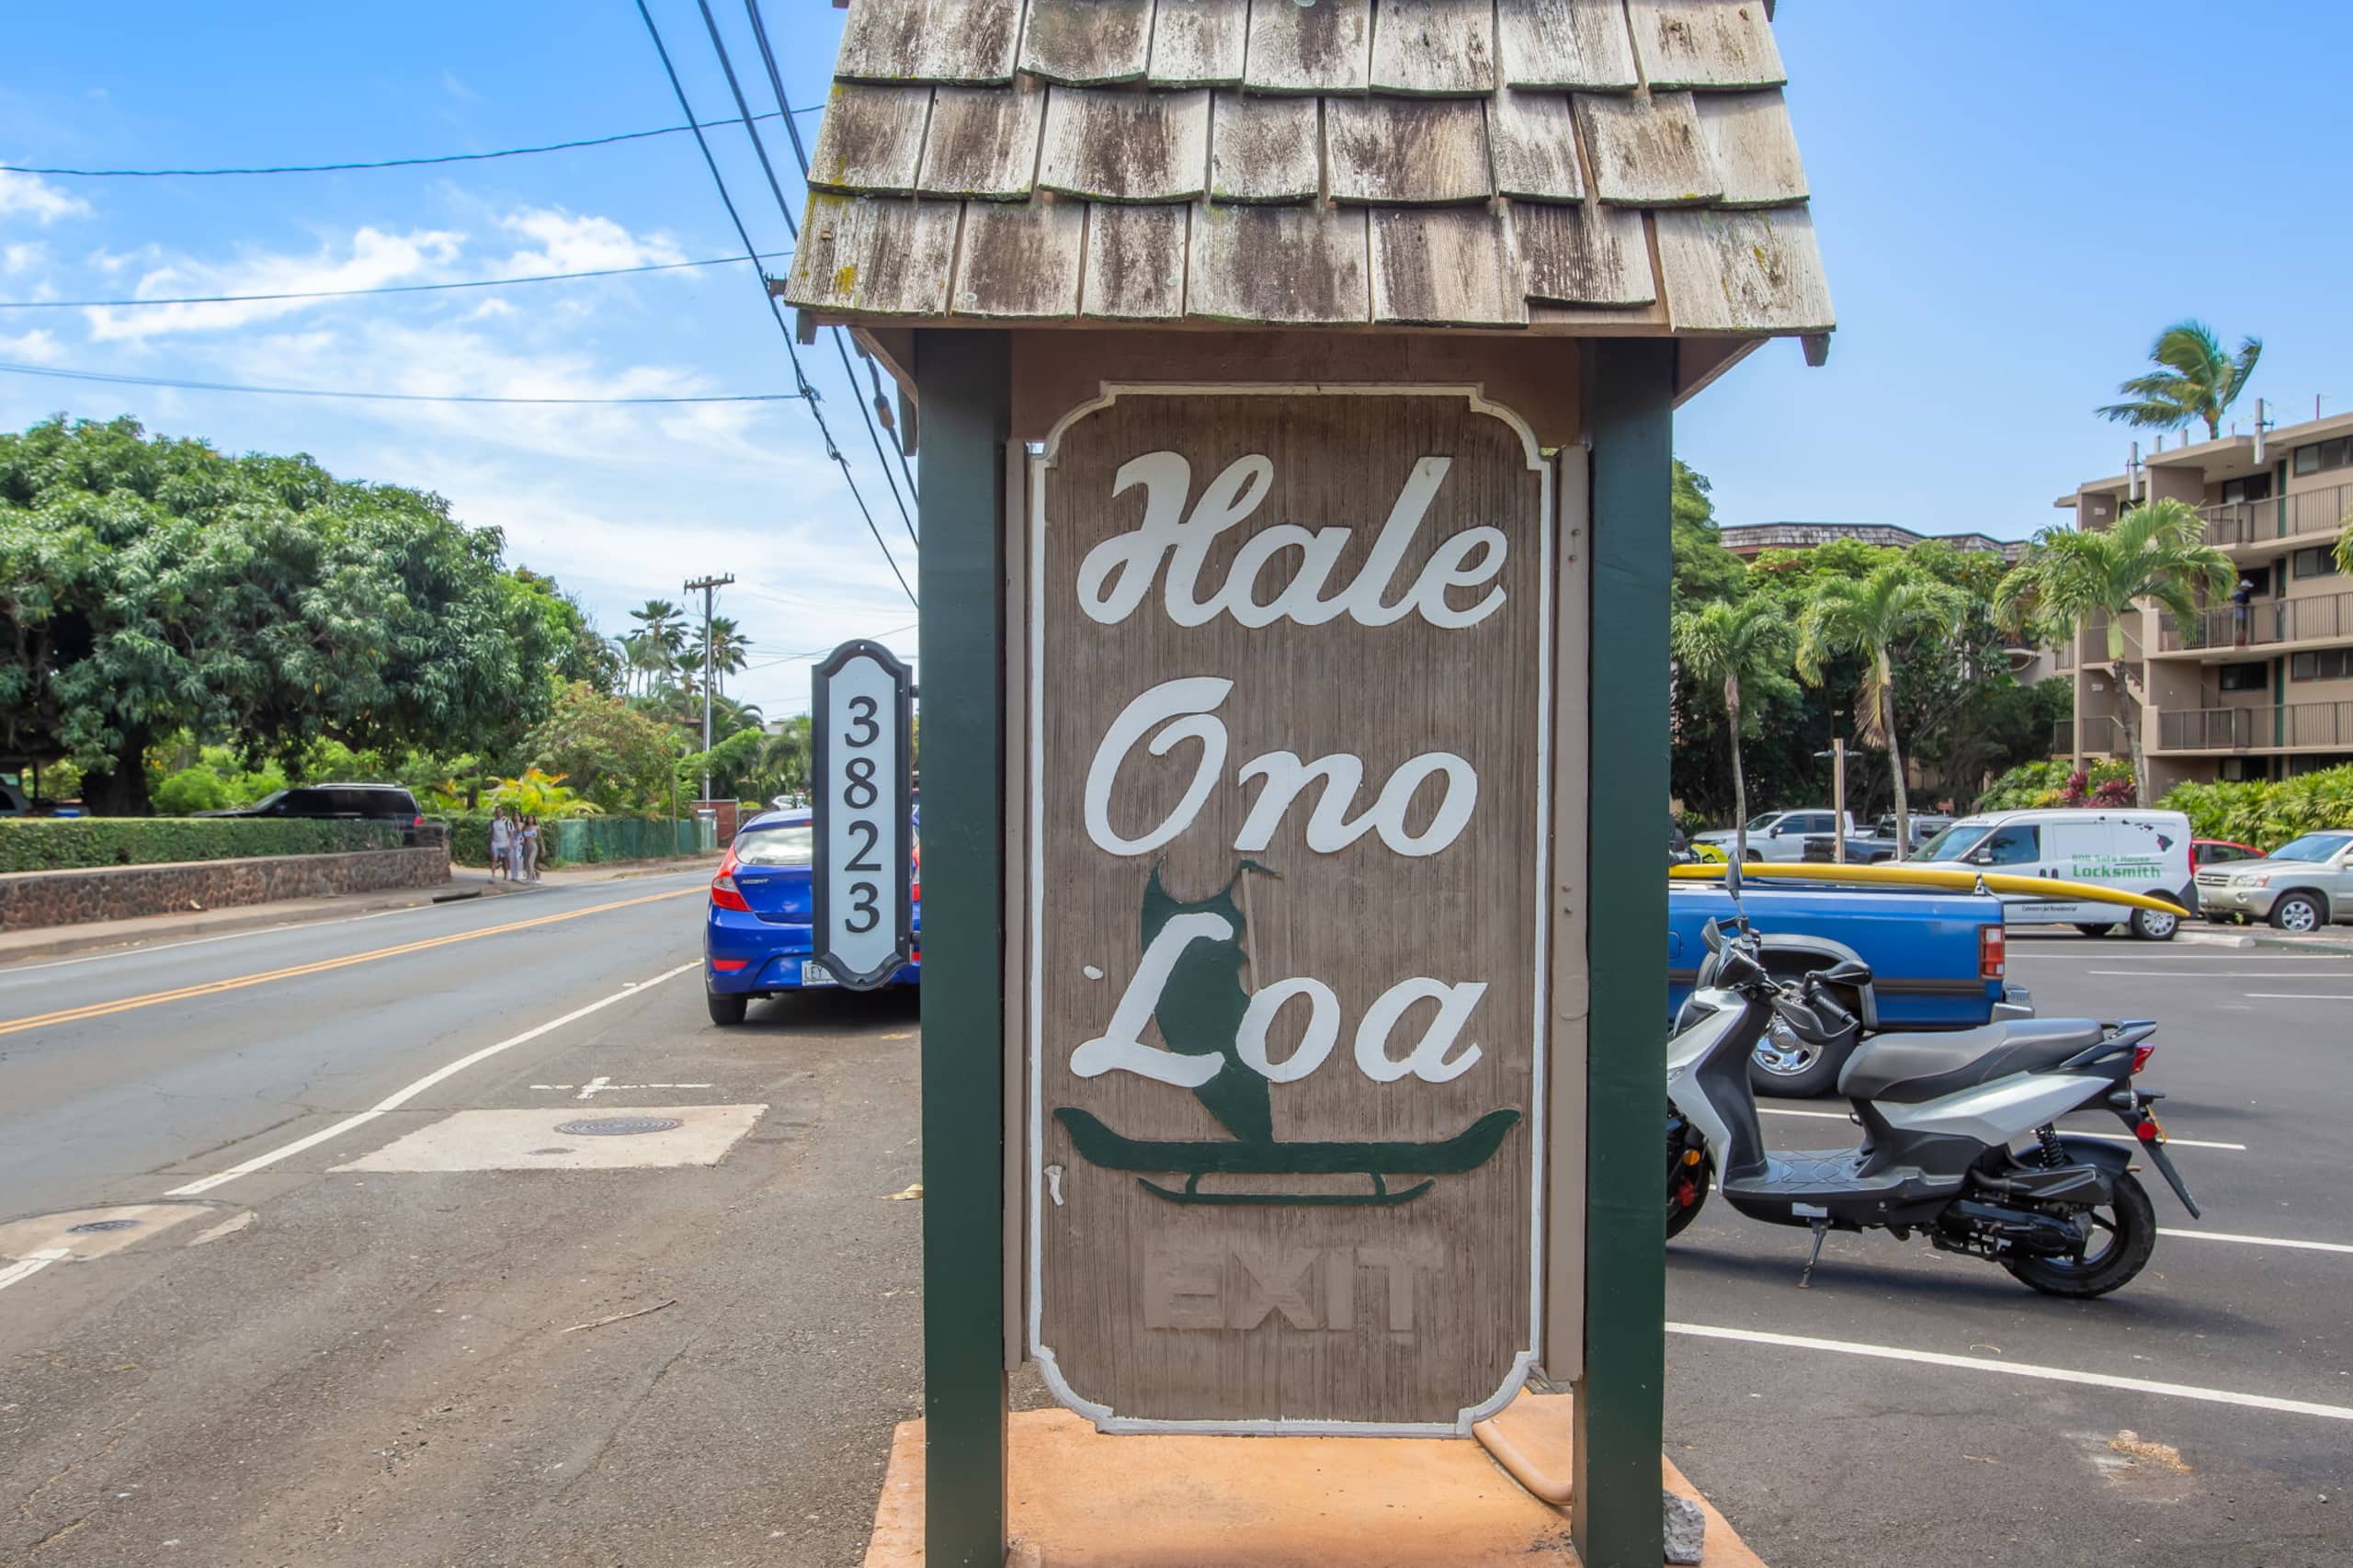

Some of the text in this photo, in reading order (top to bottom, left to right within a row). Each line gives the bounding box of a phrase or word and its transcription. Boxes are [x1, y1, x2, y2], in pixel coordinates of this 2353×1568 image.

[1077, 450, 1507, 629] Hale
[844, 695, 881, 934] 3823
[1085, 676, 1478, 856] Ono
[2073, 865, 2161, 878] Locksmith
[1070, 912, 1488, 1087] Loa
[1144, 1238, 1444, 1331] EXIT
